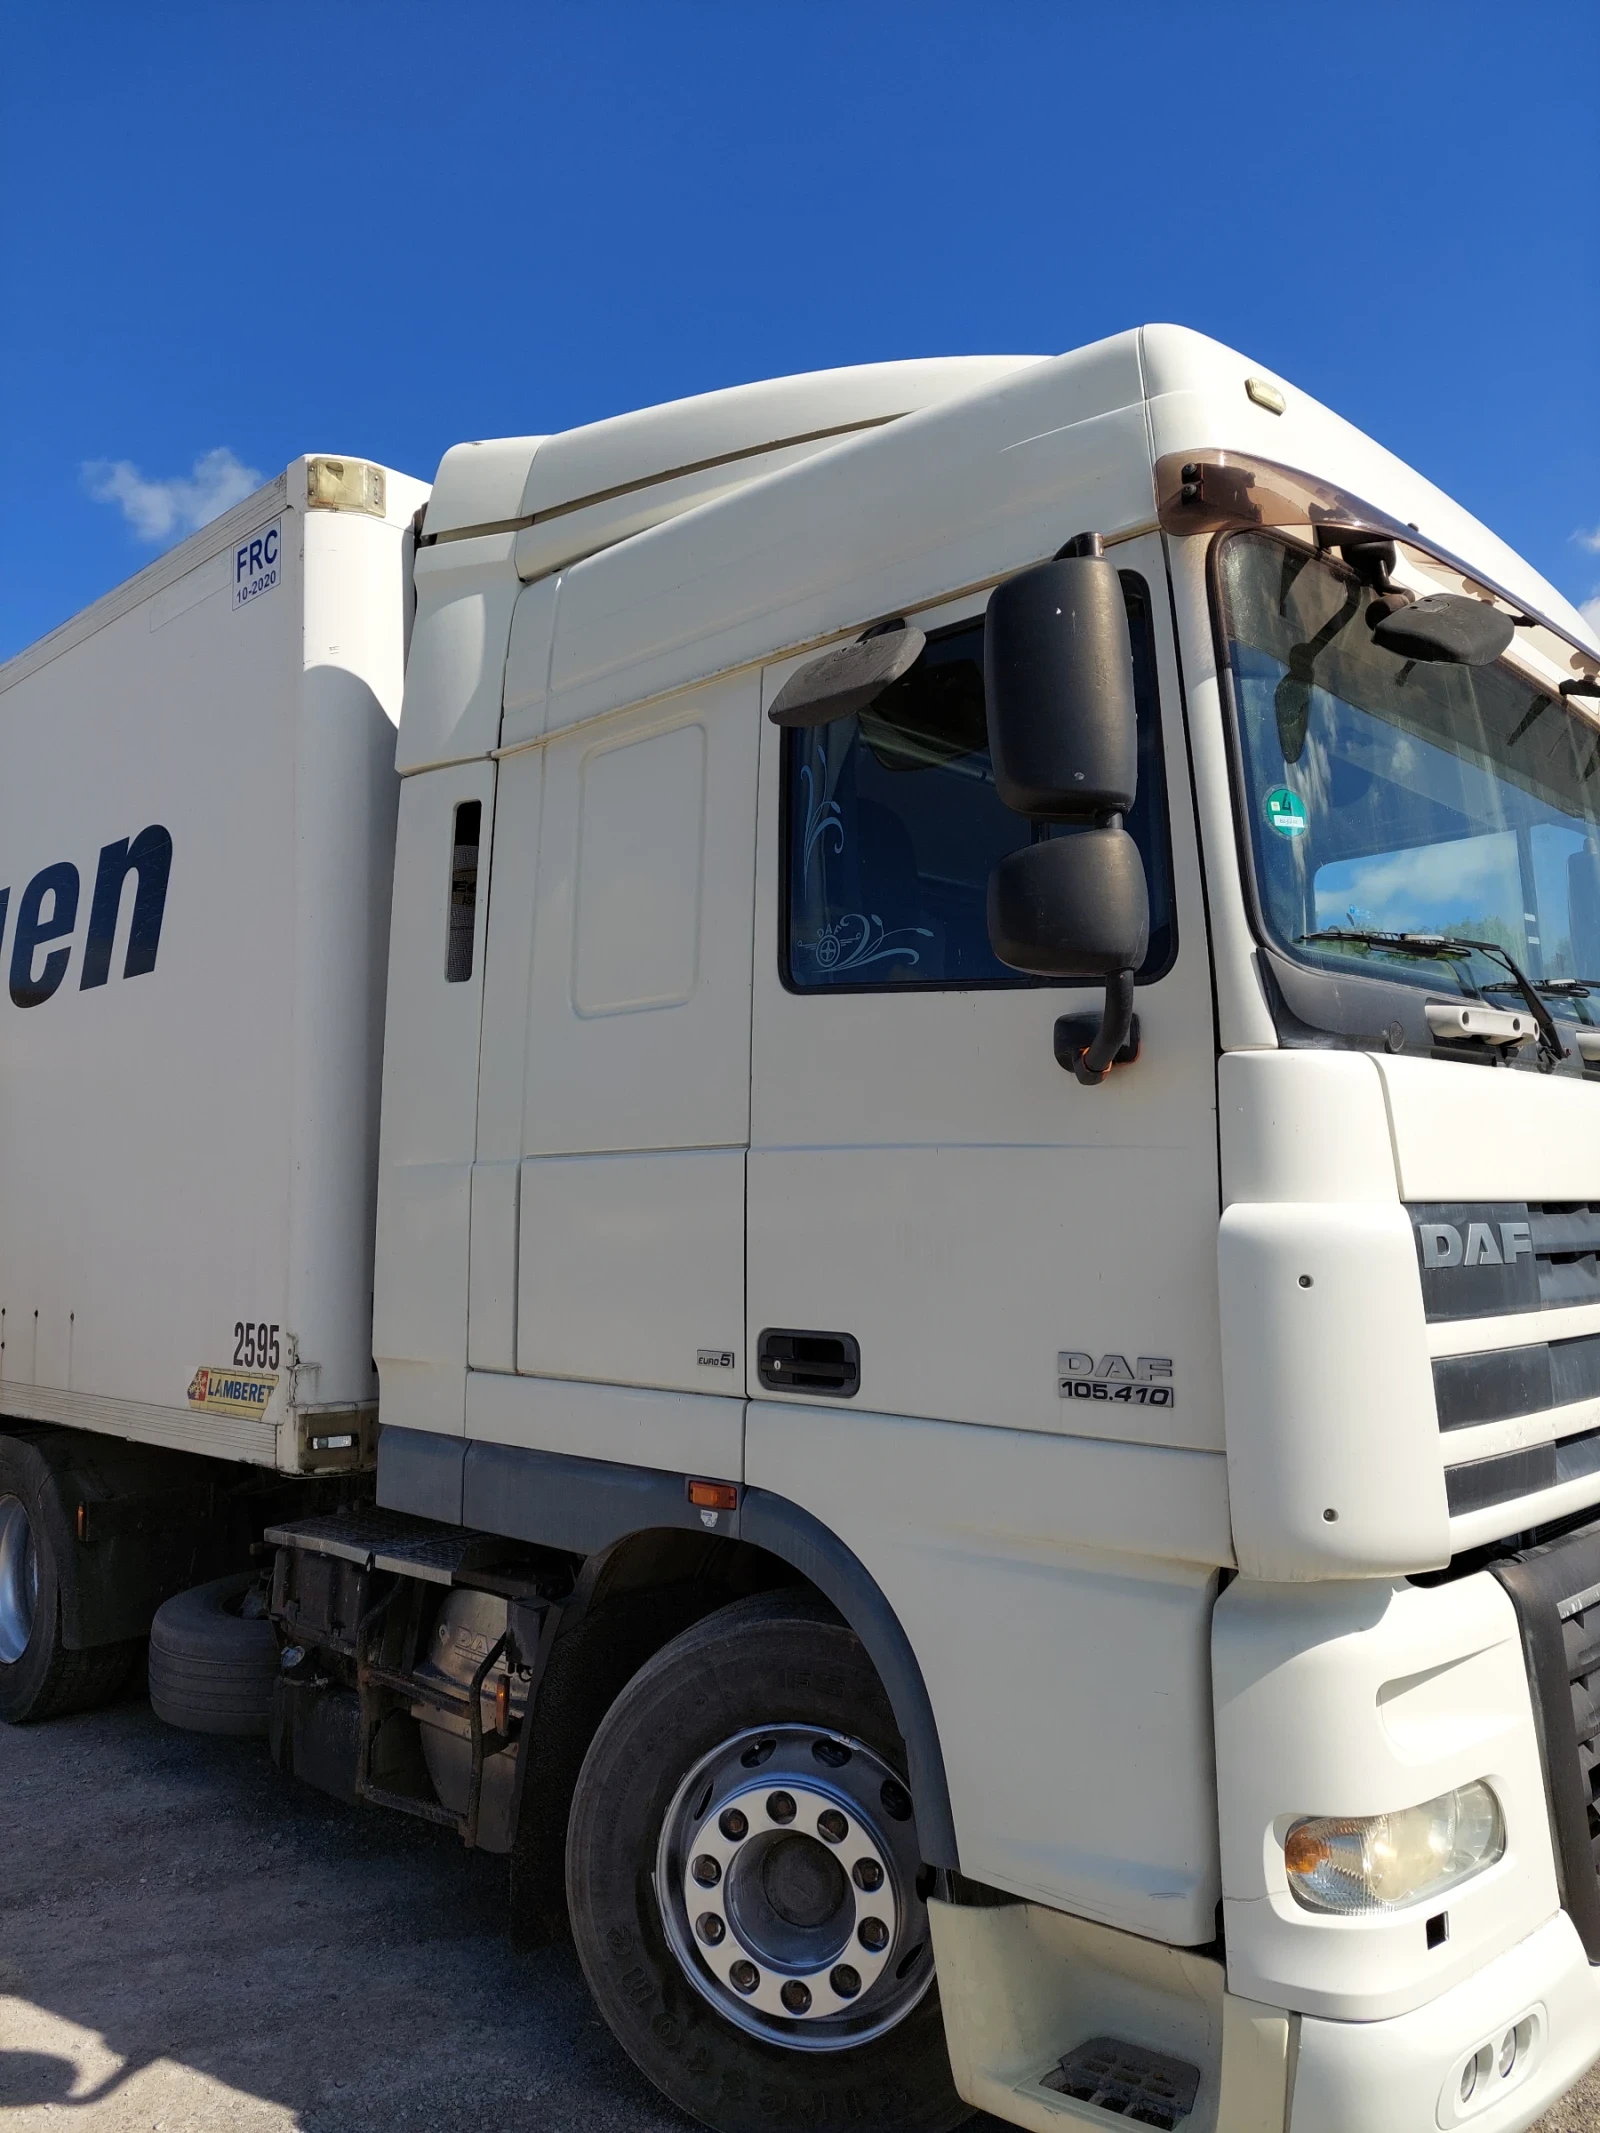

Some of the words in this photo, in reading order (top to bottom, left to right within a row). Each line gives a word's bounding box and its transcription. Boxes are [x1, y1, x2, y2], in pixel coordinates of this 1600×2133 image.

[237, 529, 278, 584] FRC
[236, 569, 277, 603] 10-2020
[1281, 792, 1293, 815] 4
[816, 923, 842, 938] DAF
[1418, 1222, 1533, 1269] DAF
[232, 1321, 280, 1370] 2595
[1058, 1351, 1173, 1381] DAF
[208, 1377, 275, 1404] LAMBERET
[1061, 1381, 1170, 1405] 105.410
